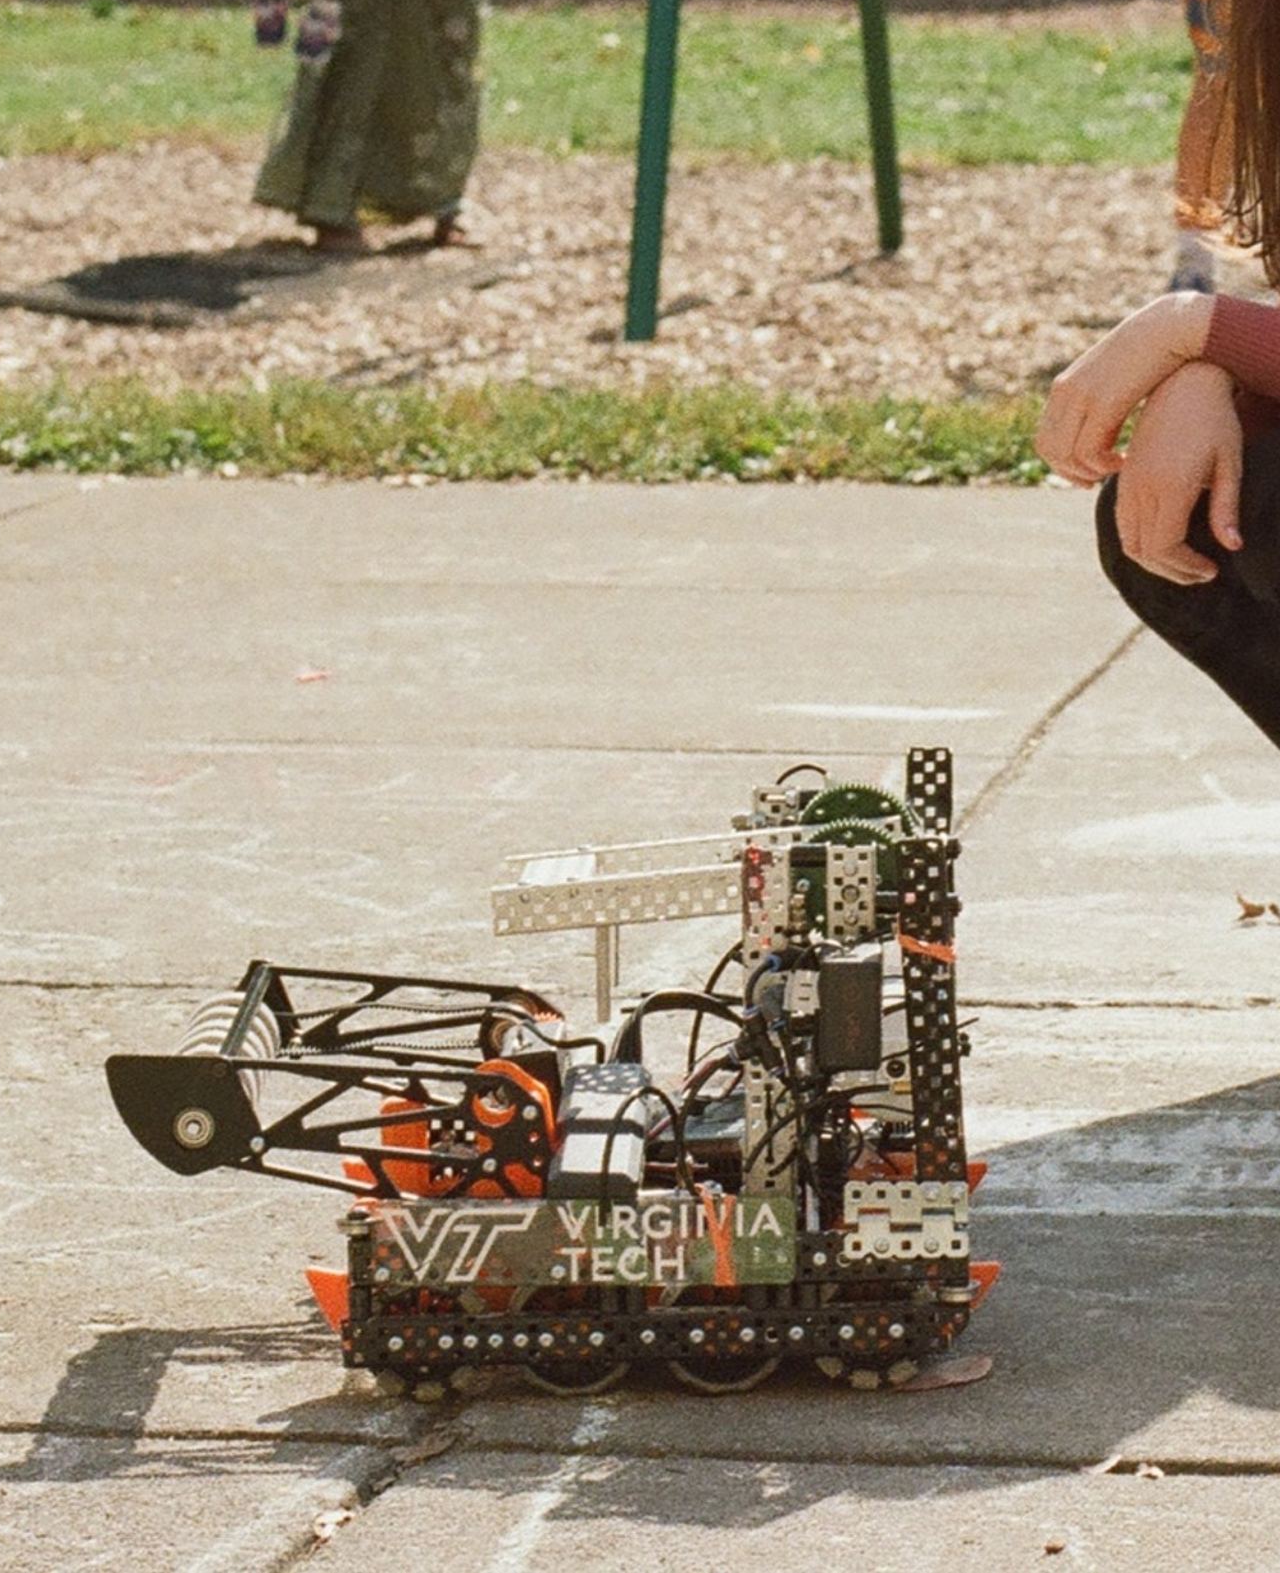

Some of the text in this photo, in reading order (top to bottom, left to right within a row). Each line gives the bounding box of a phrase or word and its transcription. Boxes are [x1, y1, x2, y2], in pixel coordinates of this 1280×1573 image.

[557, 1202, 782, 1242] VIRGINIA
[380, 1207, 539, 1283] VT
[559, 1245, 686, 1283] TECH
